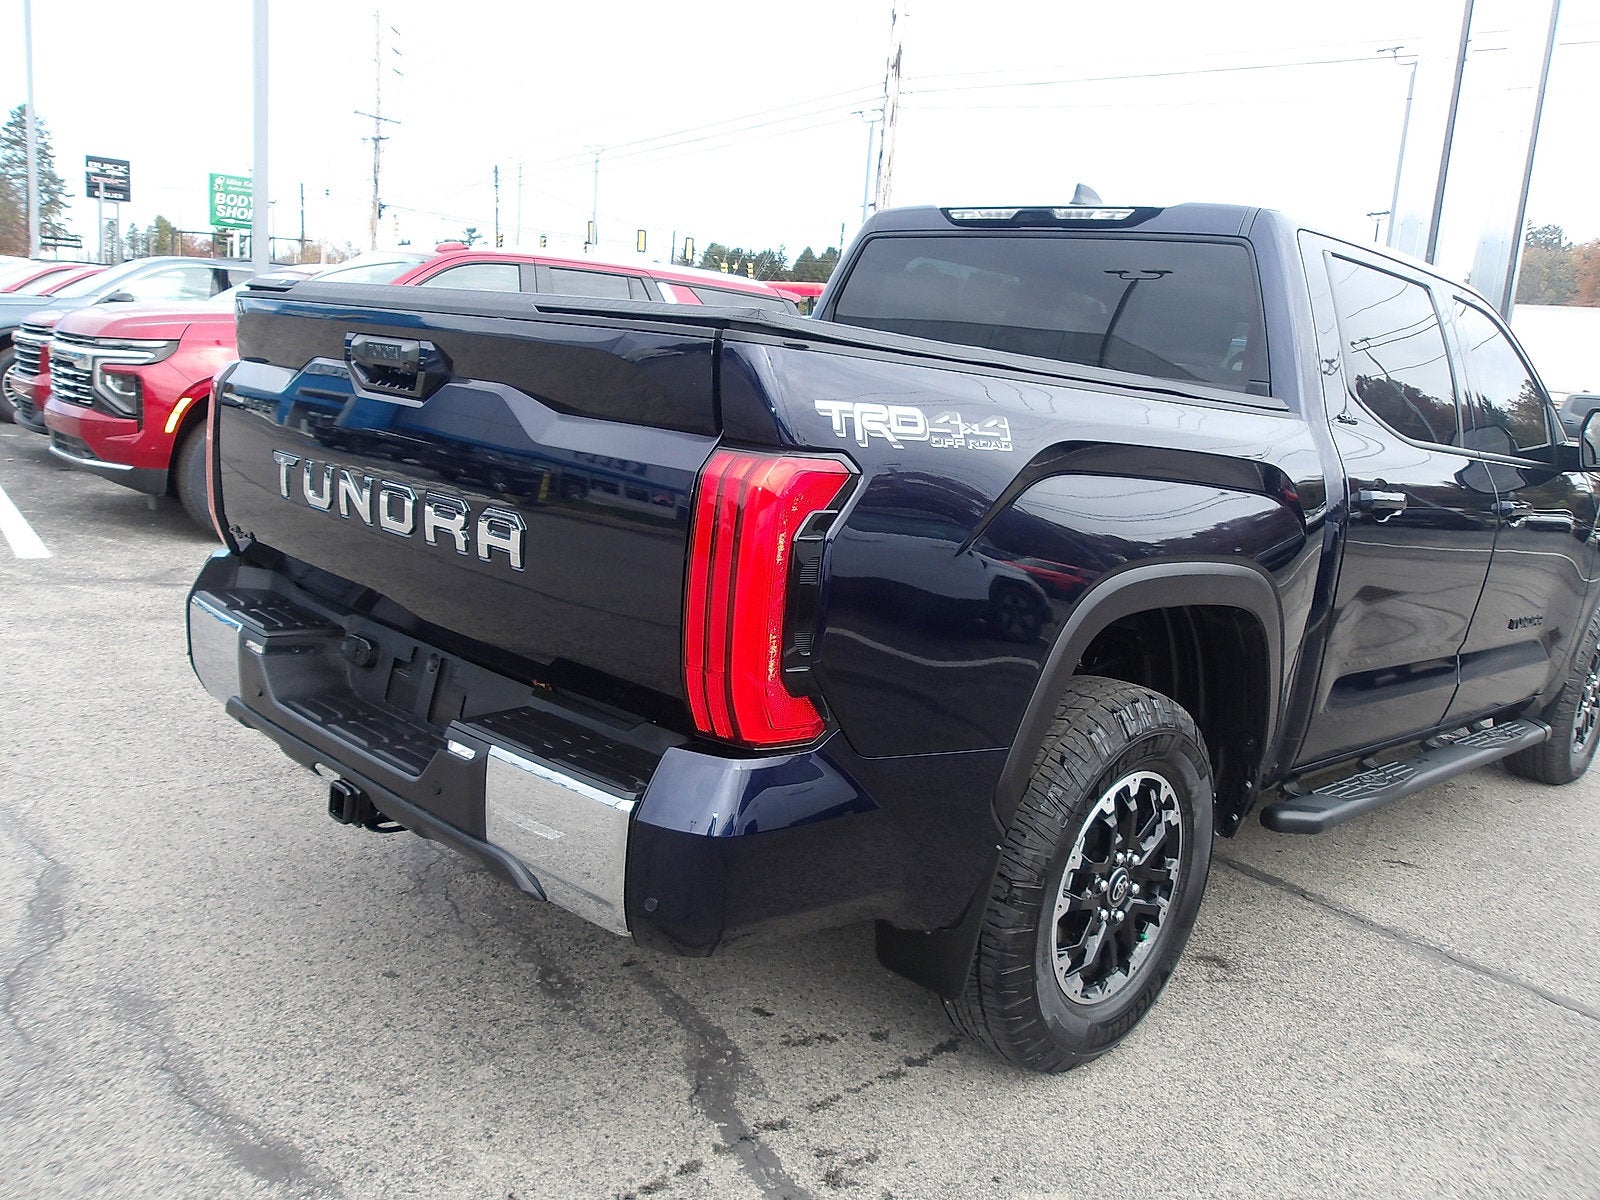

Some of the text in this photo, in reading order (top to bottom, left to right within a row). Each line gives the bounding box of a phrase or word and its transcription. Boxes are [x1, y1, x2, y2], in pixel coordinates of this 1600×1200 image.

[88, 161, 129, 174] BUICK
[226, 178, 243, 187] Mike
[814, 400, 930, 450] TRD
[930, 435, 1014, 452] OFF ROAD
[272, 449, 528, 573] TUNDRA
